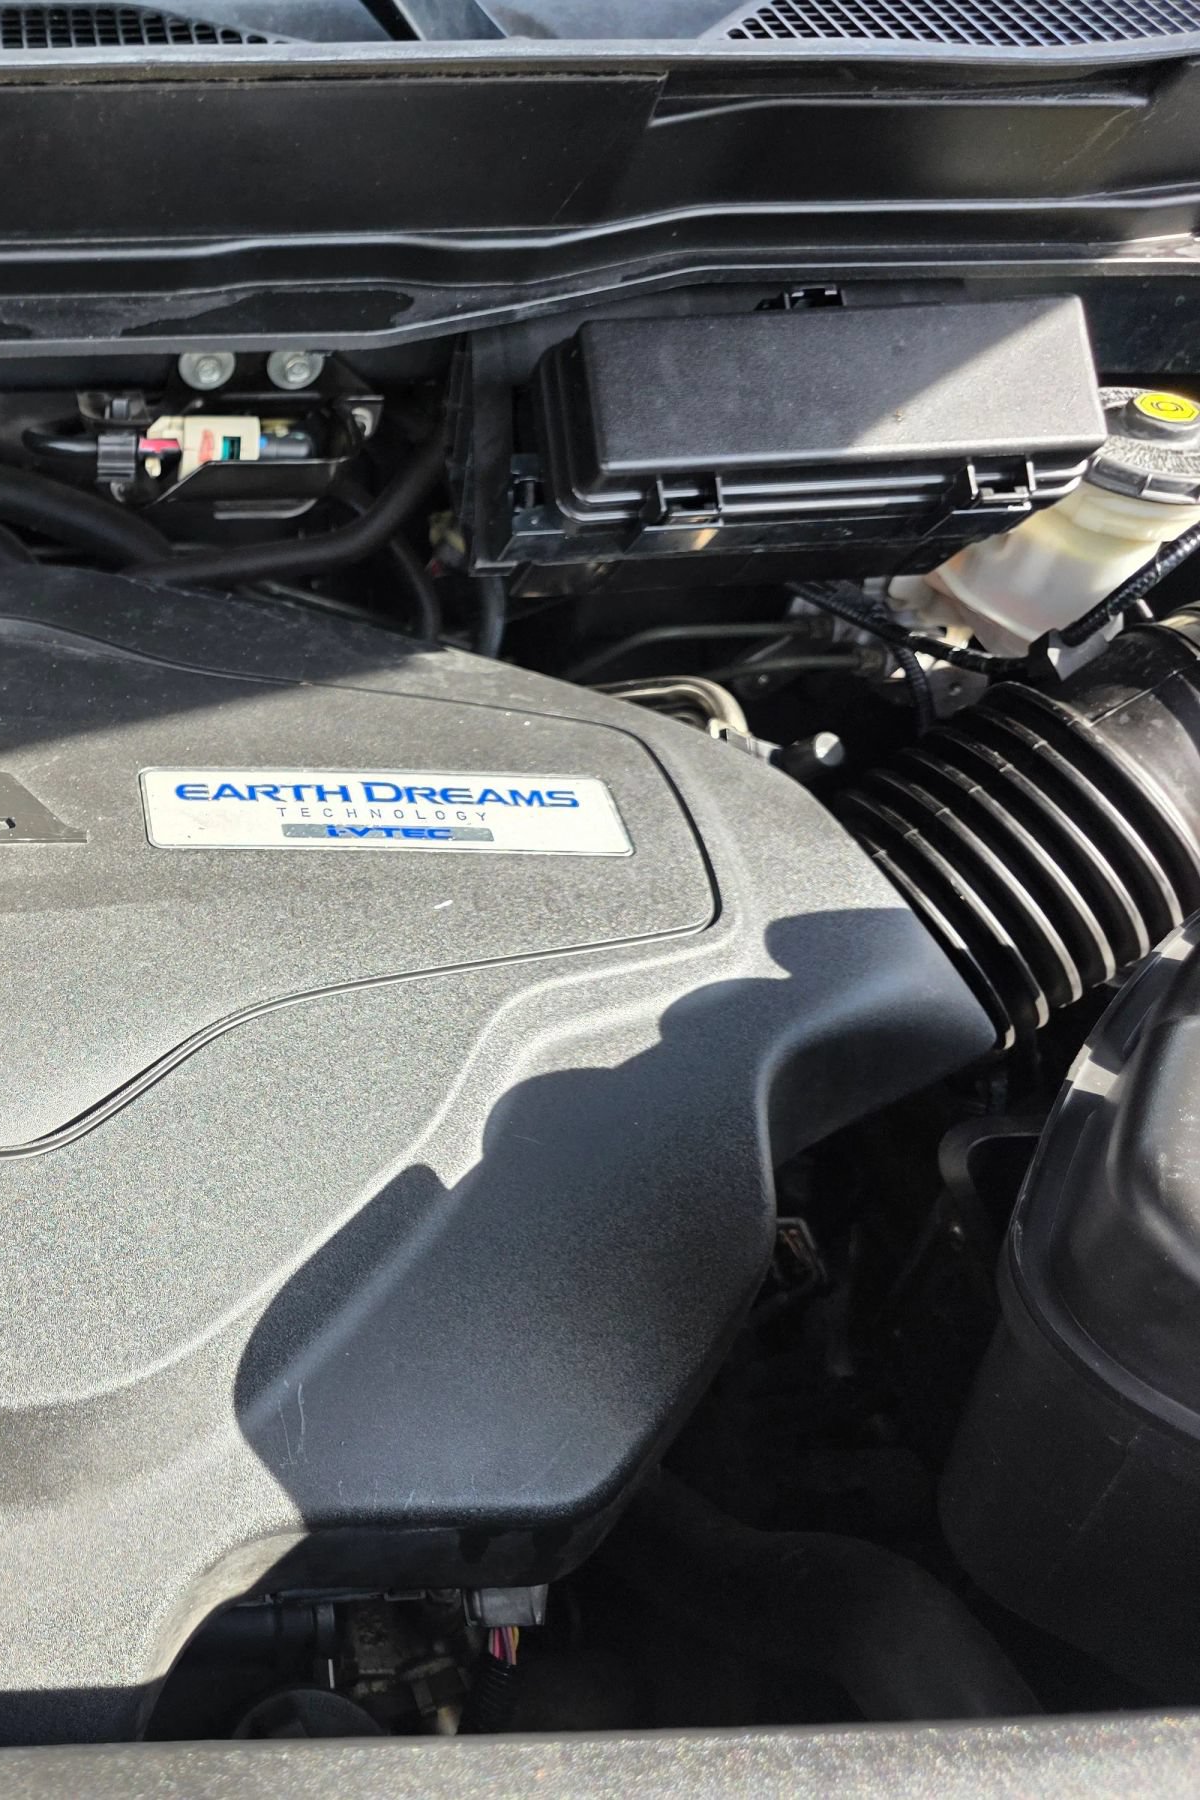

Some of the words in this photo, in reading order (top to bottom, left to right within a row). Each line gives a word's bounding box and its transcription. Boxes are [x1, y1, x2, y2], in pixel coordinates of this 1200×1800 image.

[175, 784, 352, 803] EARTH
[359, 781, 580, 808] DREAMS
[276, 807, 488, 822] TECHNOLOGY
